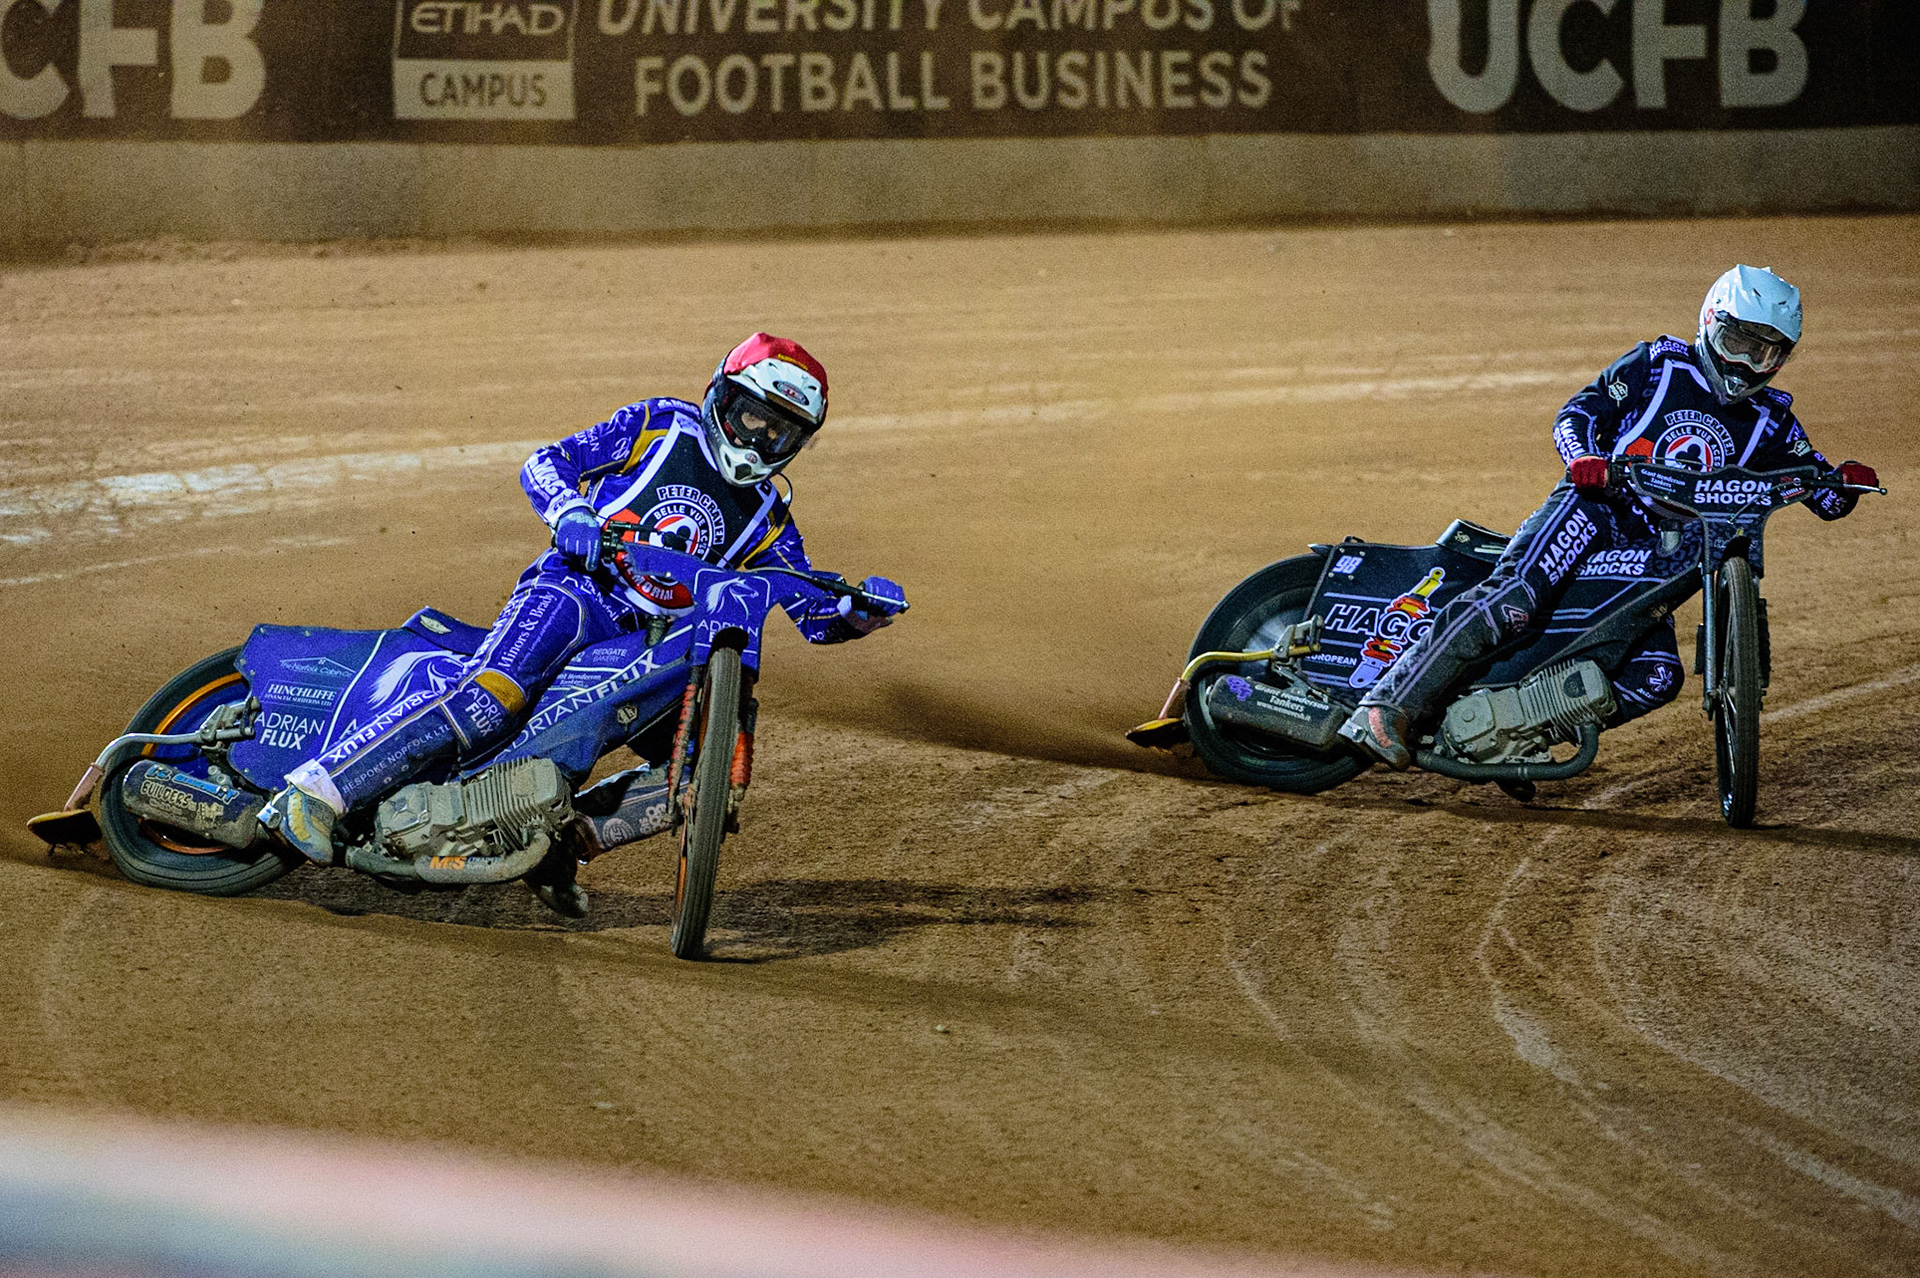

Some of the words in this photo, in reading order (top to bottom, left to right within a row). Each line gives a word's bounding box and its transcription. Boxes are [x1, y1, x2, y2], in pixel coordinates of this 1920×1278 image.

[411, 2, 566, 36] ETIHAD
[598, 0, 946, 35] UNIVERSITY
[967, 0, 1218, 31] CAMPUS
[418, 72, 548, 108] CAMPUS
[634, 53, 951, 116] FOOTBALL
[970, 51, 1273, 110] BUSINESS
[1664, 409, 1702, 426] PETER
[1702, 413, 1736, 456] CRAVEN
[1665, 426, 1693, 443] BELLE
[1695, 427, 1713, 442] VUE
[1710, 444, 1721, 467] ACES
[1693, 493, 1772, 506] SHOCKS
[1694, 479, 1772, 494] HAGON
[654, 505, 685, 520] BELLE
[690, 509, 706, 527] VUE
[700, 529, 708, 555] ACES
[656, 485, 701, 502] PETER
[699, 494, 725, 544] CRAVEN
[1538, 508, 1589, 575] HAGON
[1550, 521, 1598, 586] SHOCKS
[1332, 555, 1363, 574] 98
[498, 630, 530, 671] Minors
[518, 618, 539, 632] &
[529, 591, 557, 618] Brady
[1324, 603, 1434, 643] HAGO
[268, 684, 337, 701] HINCHLIFFE
[597, 651, 662, 699] FLUX
[466, 687, 505, 728] ADRIA
[1255, 684, 1279, 697] Grant
[1281, 691, 1329, 710] Henderson
[1269, 695, 1305, 713] Tankers
[254, 712, 326, 735] ADRIAN
[465, 701, 493, 735] FLUX
[260, 729, 306, 750] FLUX
[329, 729, 377, 764] FLUX
[342, 762, 387, 794] BESPOKE
[390, 734, 434, 763] NORFOLK
[140, 779, 193, 808] BUILDERS
